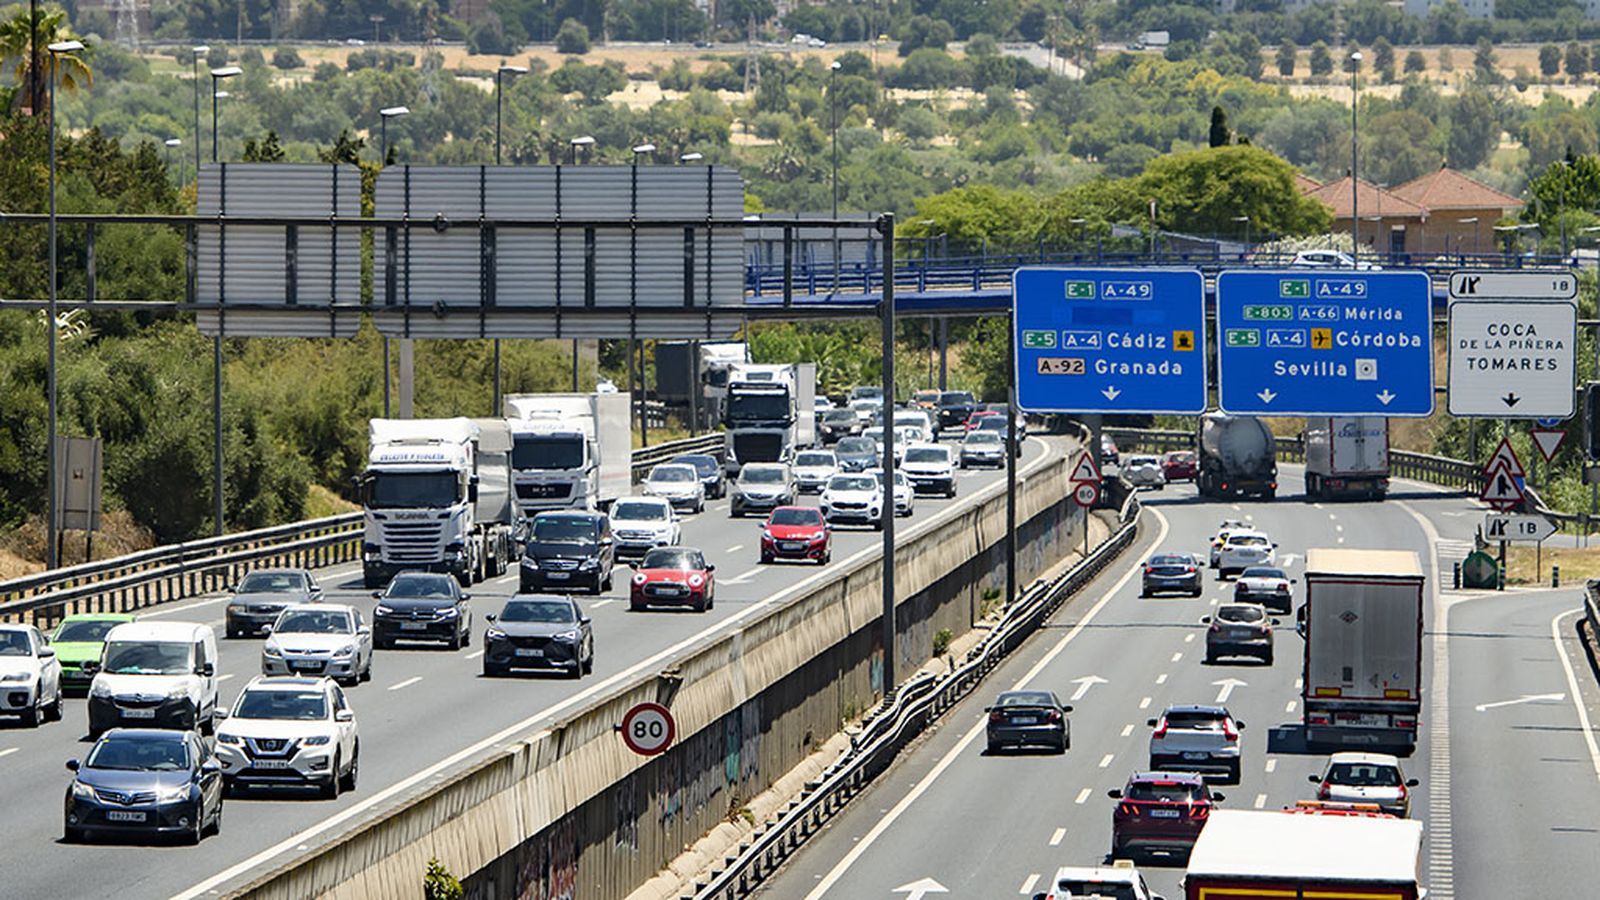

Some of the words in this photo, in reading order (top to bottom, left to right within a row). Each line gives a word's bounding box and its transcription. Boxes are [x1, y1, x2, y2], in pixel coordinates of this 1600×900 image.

[1067, 283, 1094, 297] E-1
[1104, 284, 1150, 297] A-49
[1282, 283, 1308, 295] E-1
[1319, 283, 1365, 296] A-49
[1246, 308, 1291, 319] E-803
[1300, 308, 1338, 319] A-66
[1344, 306, 1403, 320] Mérida
[1487, 323, 1537, 337] COCA
[1024, 333, 1055, 346] E-5
[1066, 334, 1099, 347] A-4
[1106, 332, 1166, 348] Cádiz
[1228, 332, 1258, 344] E-5
[1269, 332, 1303, 345] A-4
[1335, 330, 1421, 347] Córdoba
[1459, 340, 1478, 349] DE
[1485, 340, 1502, 349] LA
[1508, 338, 1564, 350] PIÑERA
[1039, 360, 1084, 373] A-92
[1094, 359, 1183, 375] Granada
[1273, 360, 1348, 376] Sevilla
[1466, 357, 1558, 371] TOMARES
[1519, 523, 1537, 534] 1B
[633, 720, 663, 738] 80
